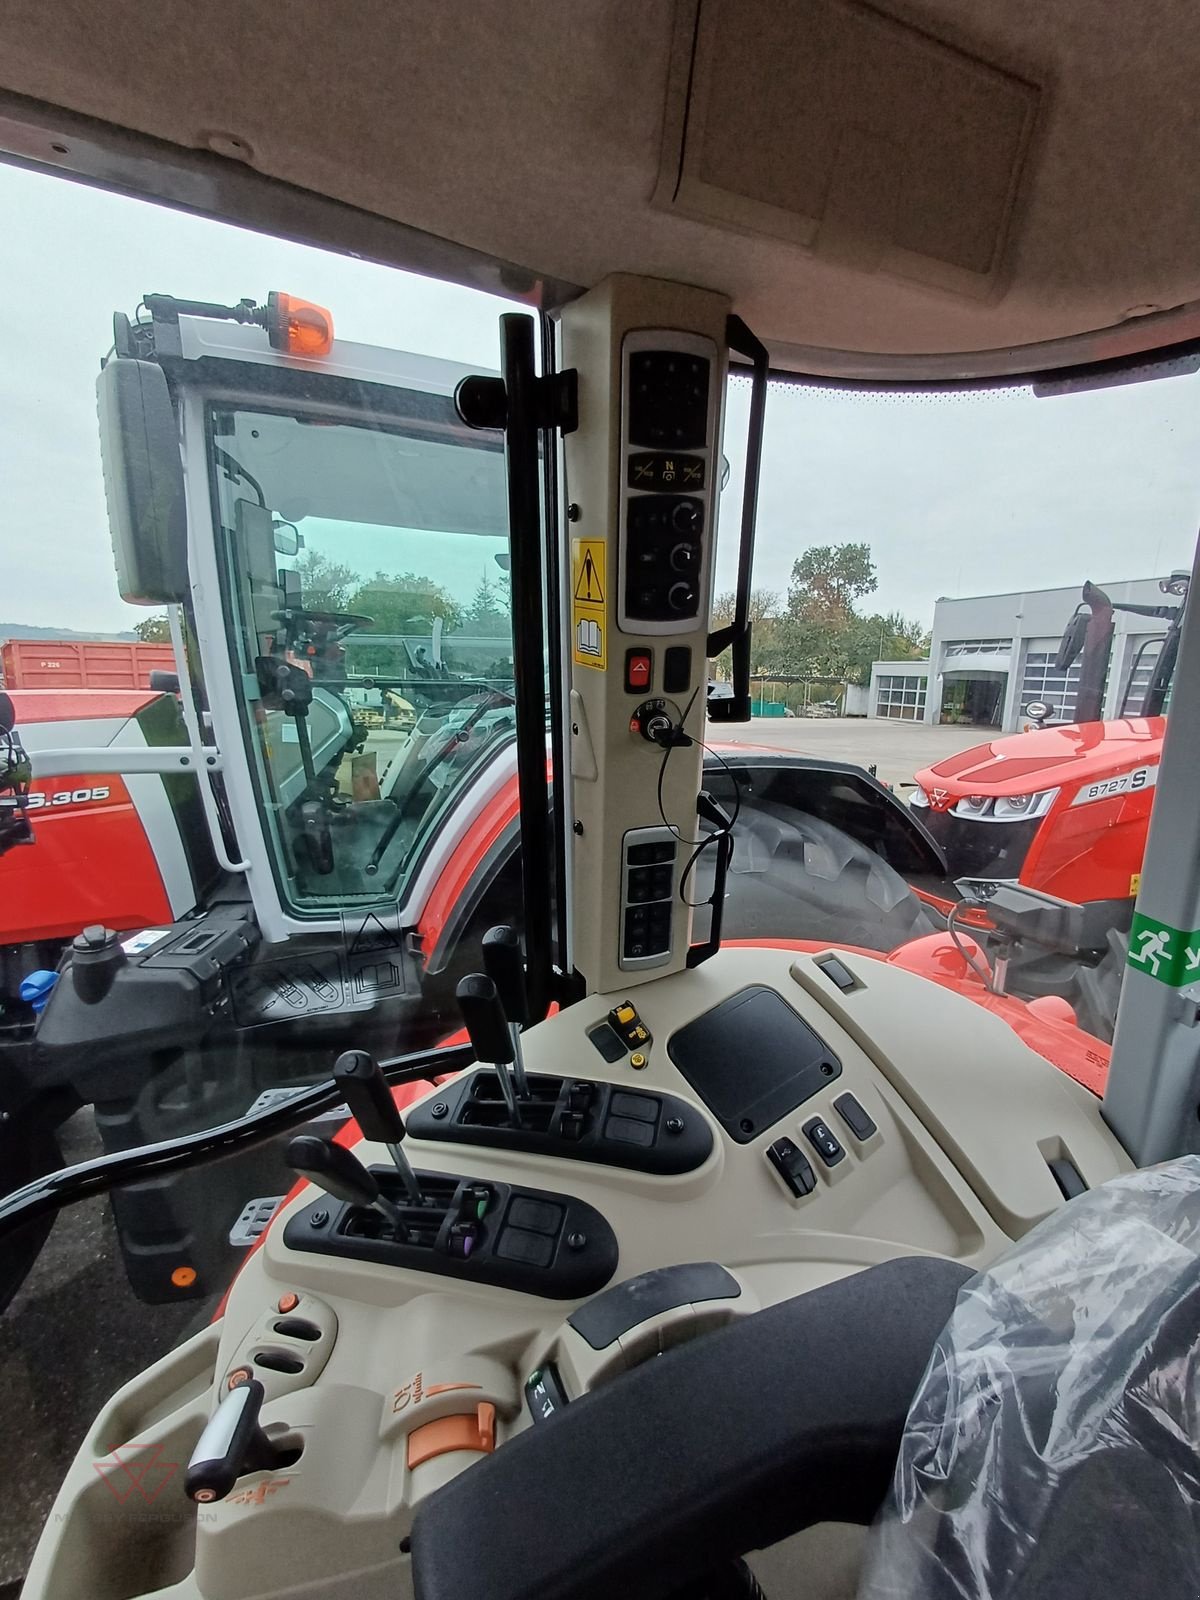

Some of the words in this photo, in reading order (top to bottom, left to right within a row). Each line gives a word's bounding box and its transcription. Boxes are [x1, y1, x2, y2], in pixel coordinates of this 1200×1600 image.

[665, 461, 674, 471] N
[1088, 779, 1128, 798] 8727
[1131, 770, 1147, 788] S
[17, 787, 109, 809] S.305
